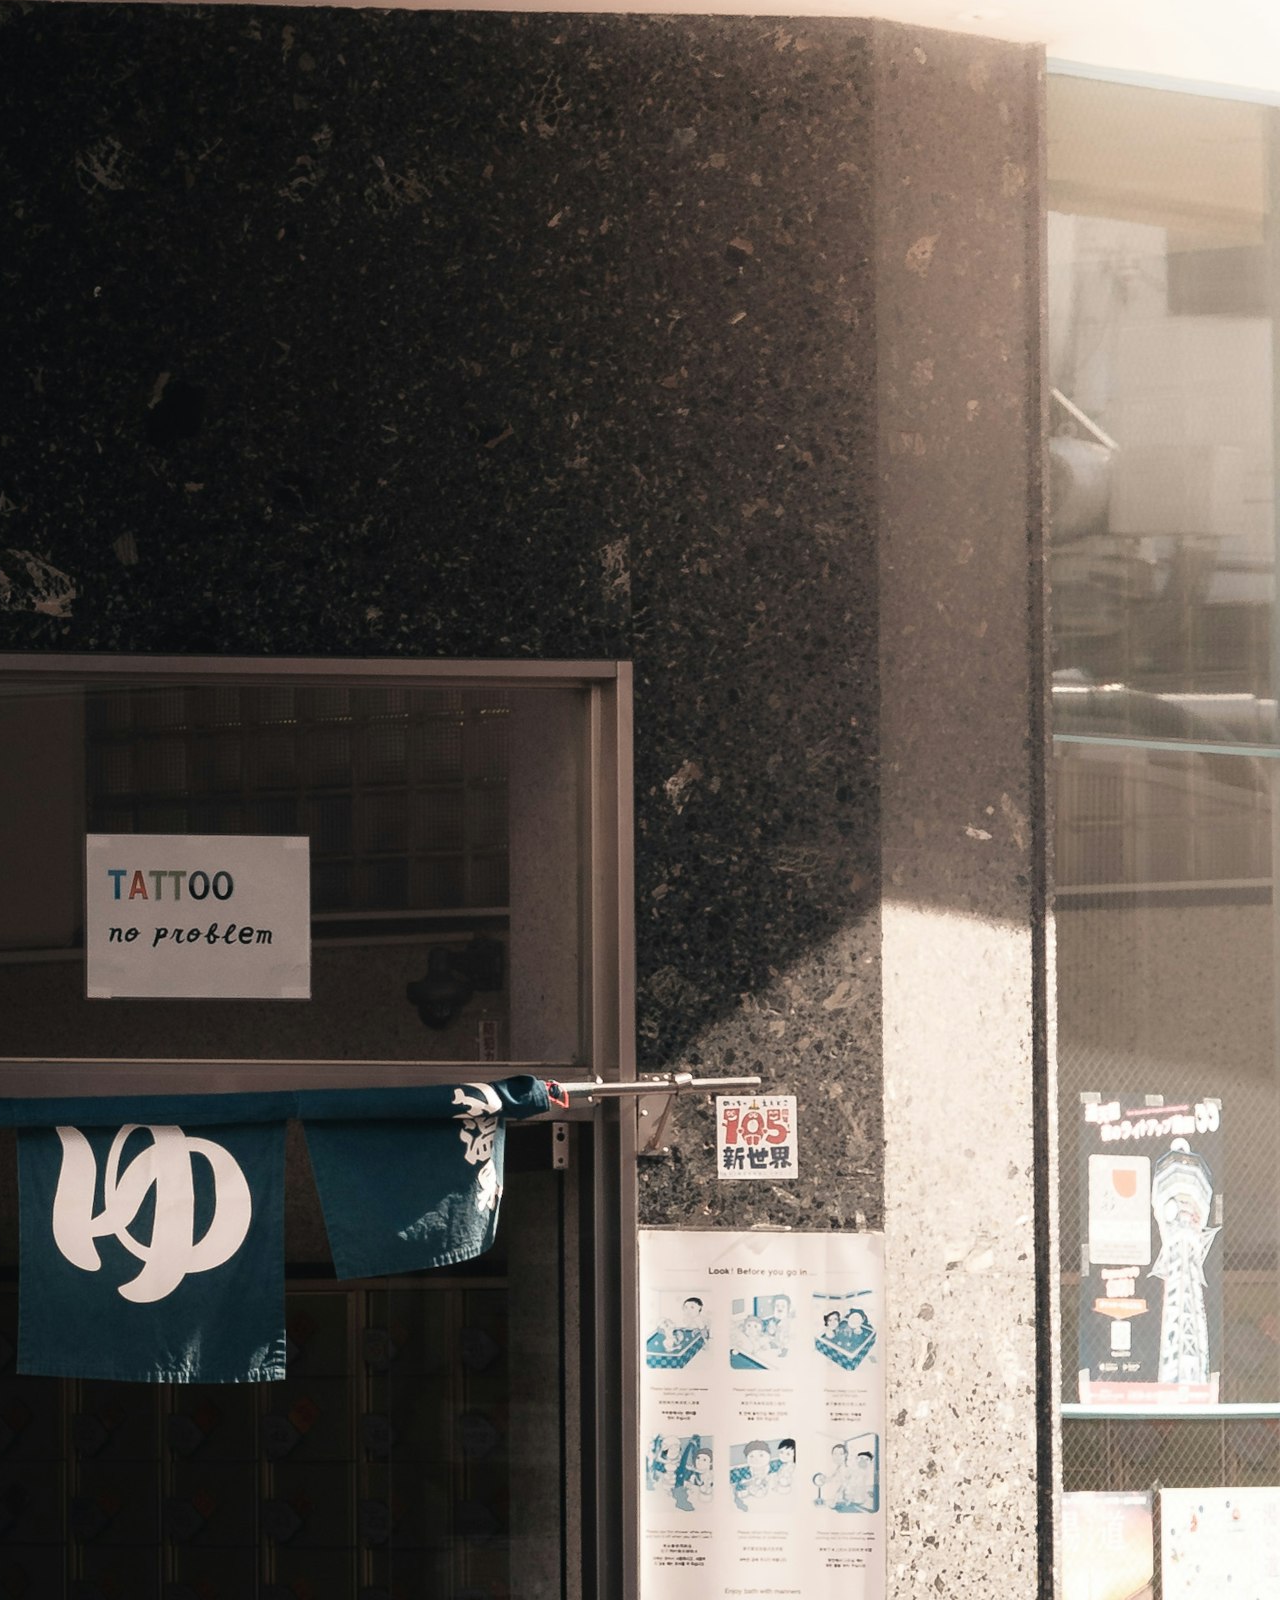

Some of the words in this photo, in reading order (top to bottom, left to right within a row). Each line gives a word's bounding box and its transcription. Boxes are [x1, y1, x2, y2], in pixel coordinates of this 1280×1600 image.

[107, 869, 234, 902] TATTOO
[108, 926, 141, 944] no
[152, 921, 274, 947] problem
[722, 1107, 789, 1146] 105
[722, 1145, 793, 1170] 新世界
[52, 1123, 253, 1304] ゆ
[736, 1266, 766, 1276] Before
[768, 1268, 784, 1278] you
[786, 1268, 798, 1278] go
